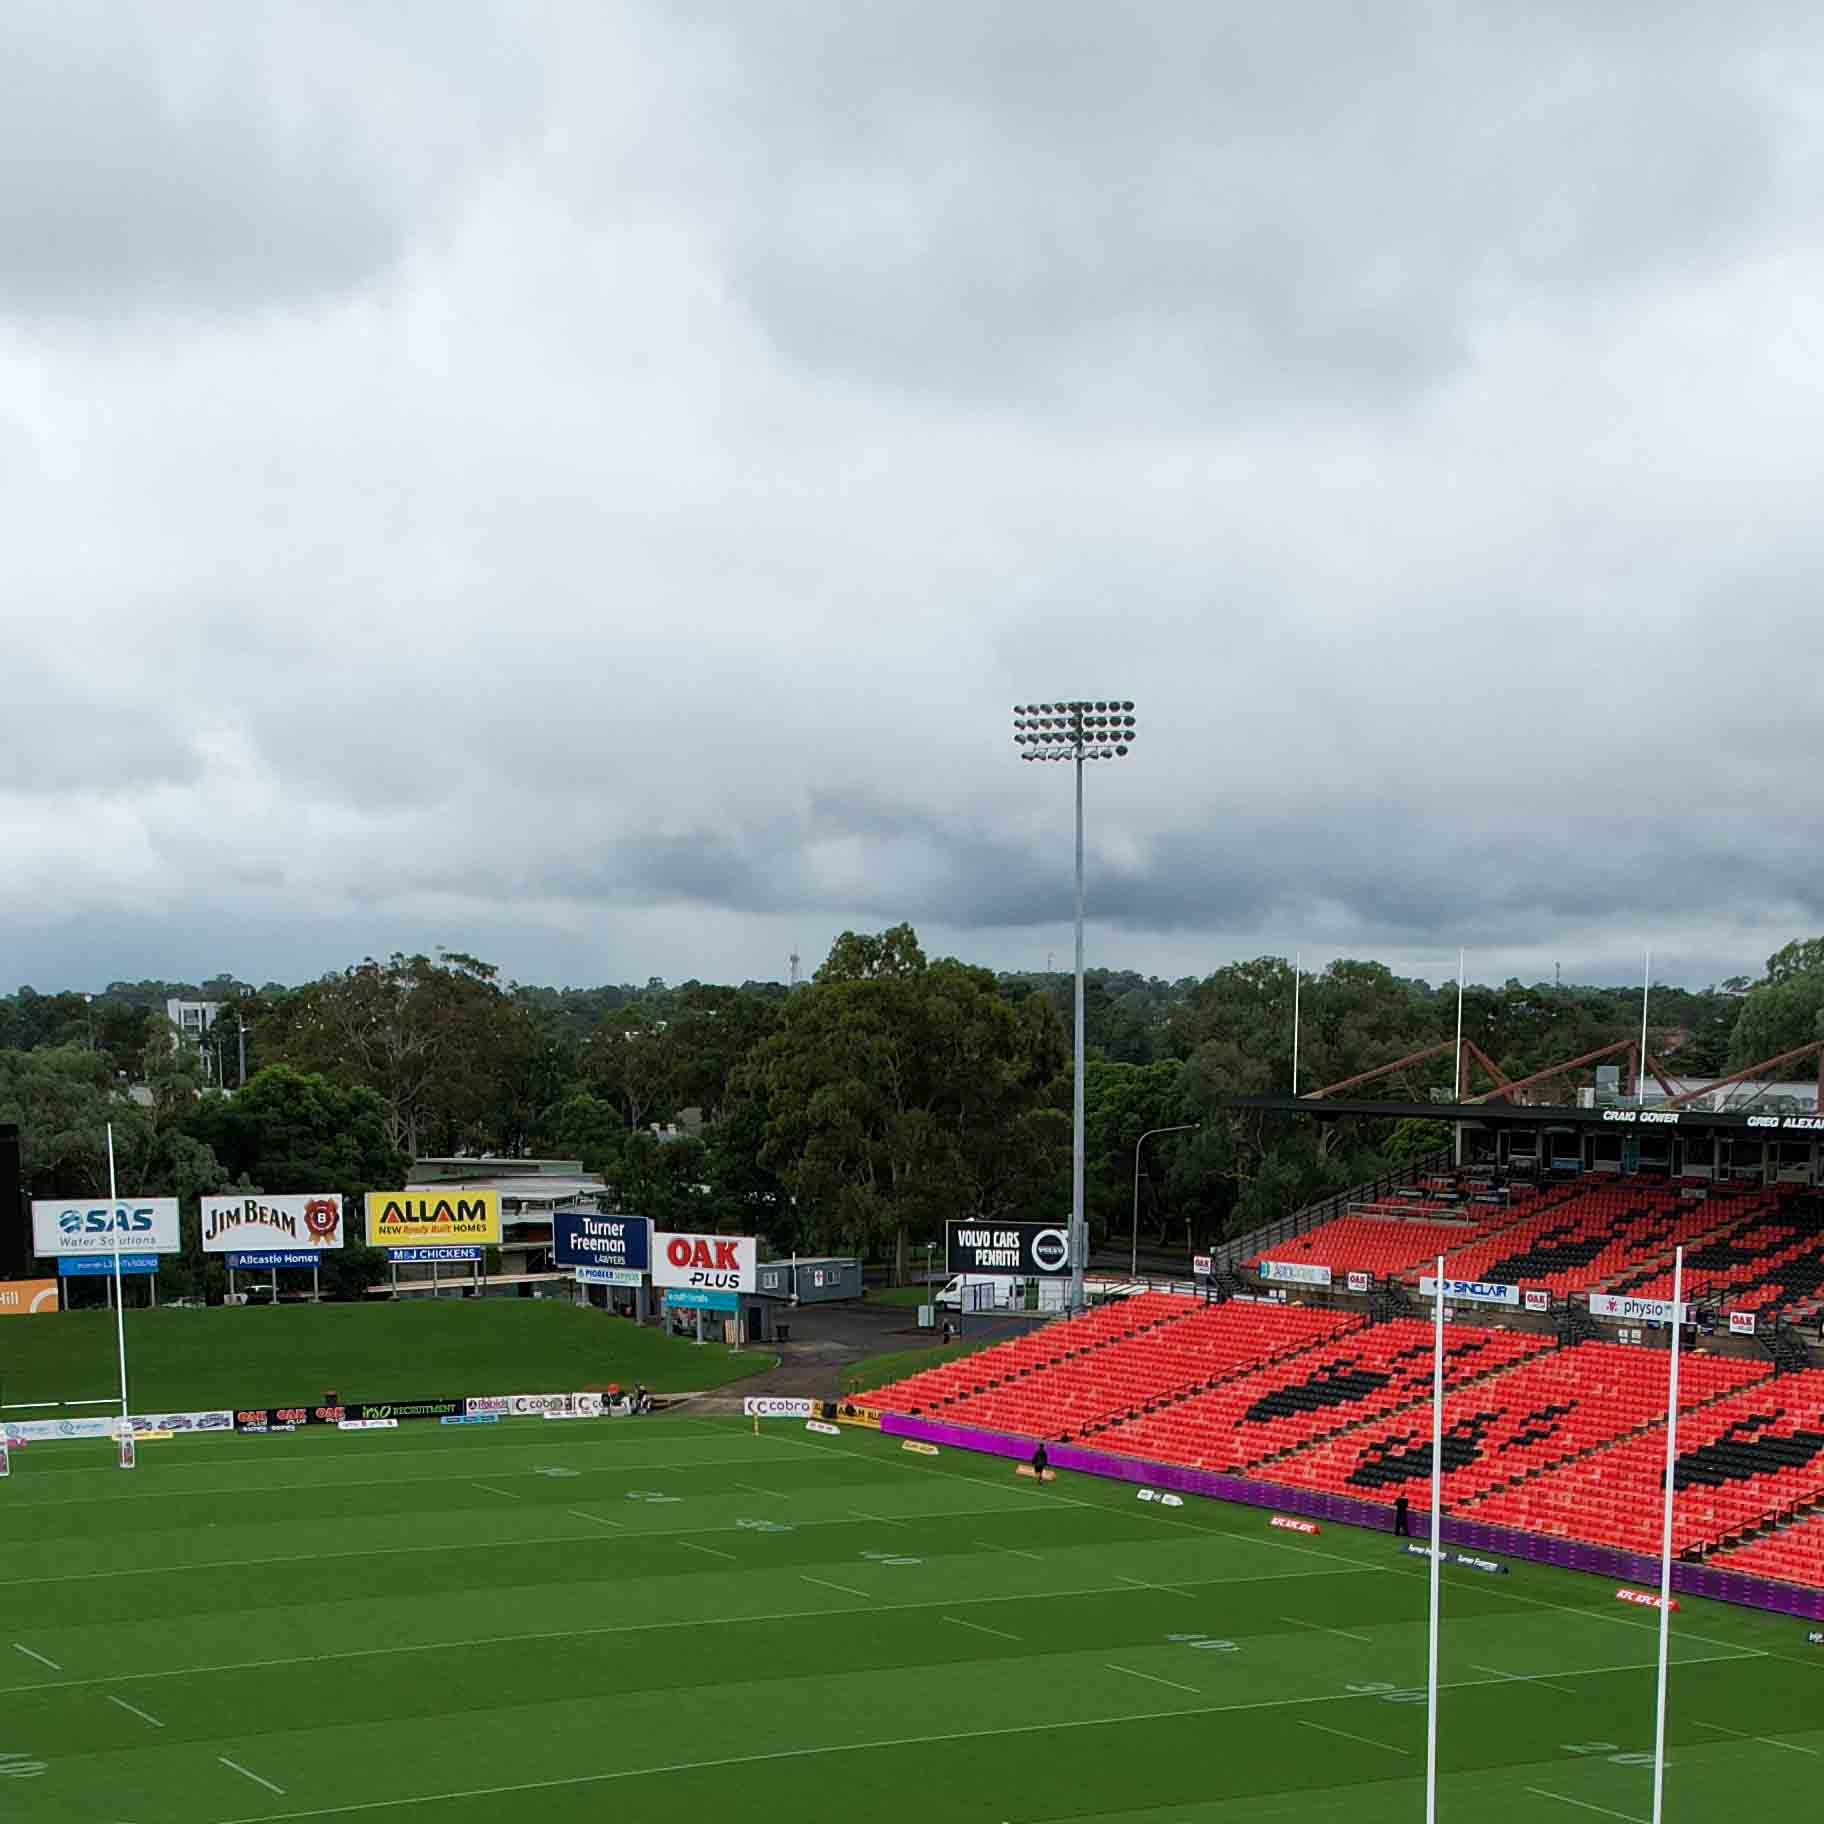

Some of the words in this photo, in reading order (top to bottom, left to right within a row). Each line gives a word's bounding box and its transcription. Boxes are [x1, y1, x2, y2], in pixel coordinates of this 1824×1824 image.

[1603, 1111, 1636, 1122] CRAIG
[1640, 1112, 1679, 1124] GOWER
[1747, 1116, 1778, 1128] GREG
[380, 1199, 487, 1223] ALLAM
[85, 1208, 154, 1233] SAS
[205, 1208, 241, 1241] JIM
[243, 1199, 297, 1239] BEAM
[582, 1218, 625, 1237] Turner
[378, 1226, 401, 1235] NEW
[453, 1223, 487, 1234] HOMES
[59, 1235, 96, 1248] Water
[98, 1234, 156, 1247] Soutions
[570, 1234, 626, 1254] Freeman
[957, 1230, 991, 1248] VOLVO
[993, 1231, 1020, 1248] CARS
[284, 1253, 319, 1264] Homes
[420, 1247, 475, 1260] CHICKENS
[594, 1254, 626, 1265] LAWYERS
[666, 1238, 740, 1270] OAK
[975, 1249, 1020, 1267] PENRITH
[688, 1273, 740, 1289] PLUS
[1454, 1281, 1507, 1297] SINCLAIR
[1527, 1293, 1547, 1303] OAK
[1624, 1298, 1663, 1317] physio
[1732, 1315, 1753, 1326] OAK
[768, 1398, 810, 1413] cobra
[237, 1410, 268, 1422] OAK
[276, 1408, 307, 1421] OAK
[315, 1407, 345, 1419] OAK
